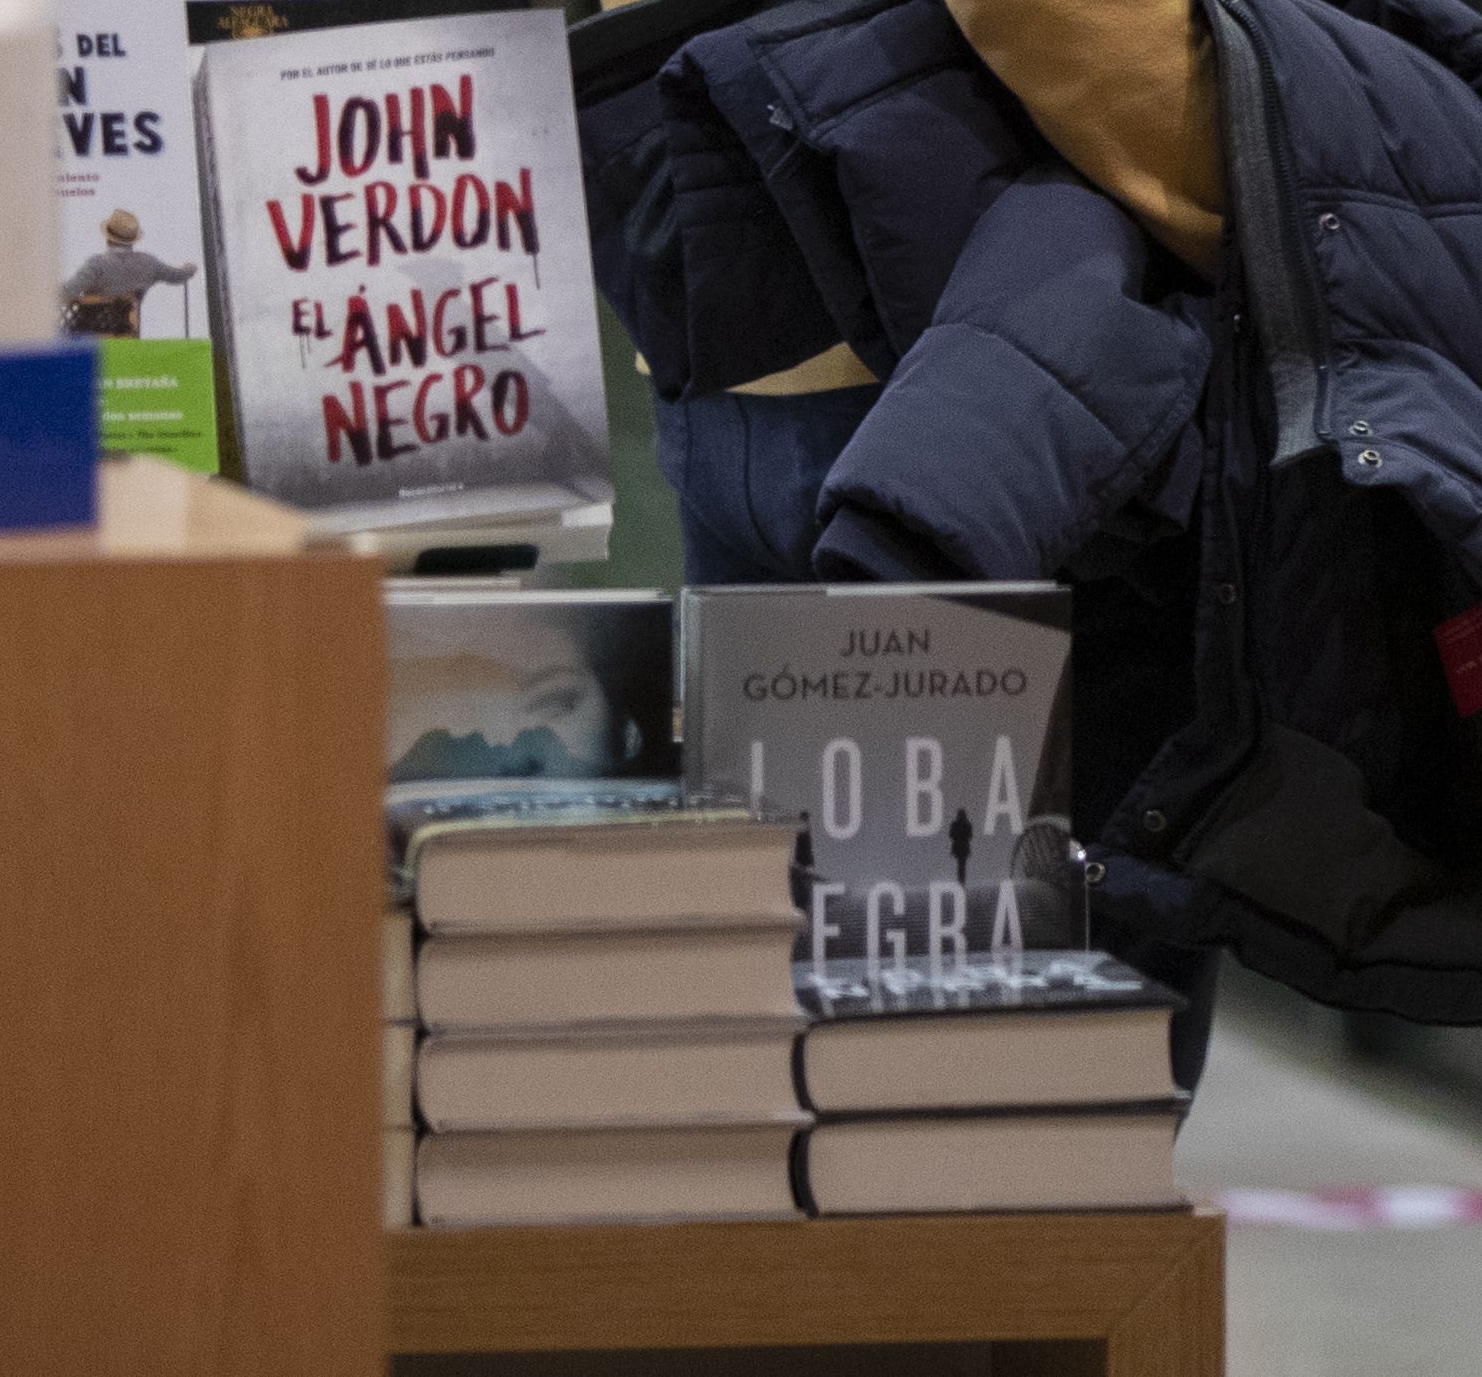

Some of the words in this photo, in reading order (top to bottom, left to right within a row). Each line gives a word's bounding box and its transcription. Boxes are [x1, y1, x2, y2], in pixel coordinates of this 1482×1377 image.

[76, 33, 127, 58] DEL
[317, 62, 349, 76] AUTOR
[55, 112, 164, 157] VES
[296, 73, 476, 187] JOHN
[267, 167, 540, 277] VERDON
[291, 295, 332, 341] EL
[327, 275, 544, 375] ÁNGEL
[322, 365, 530, 467] NEGRO
[840, 629, 930, 657] JUAN
[742, 665, 1028, 703] GÓMEZ-JURADO
